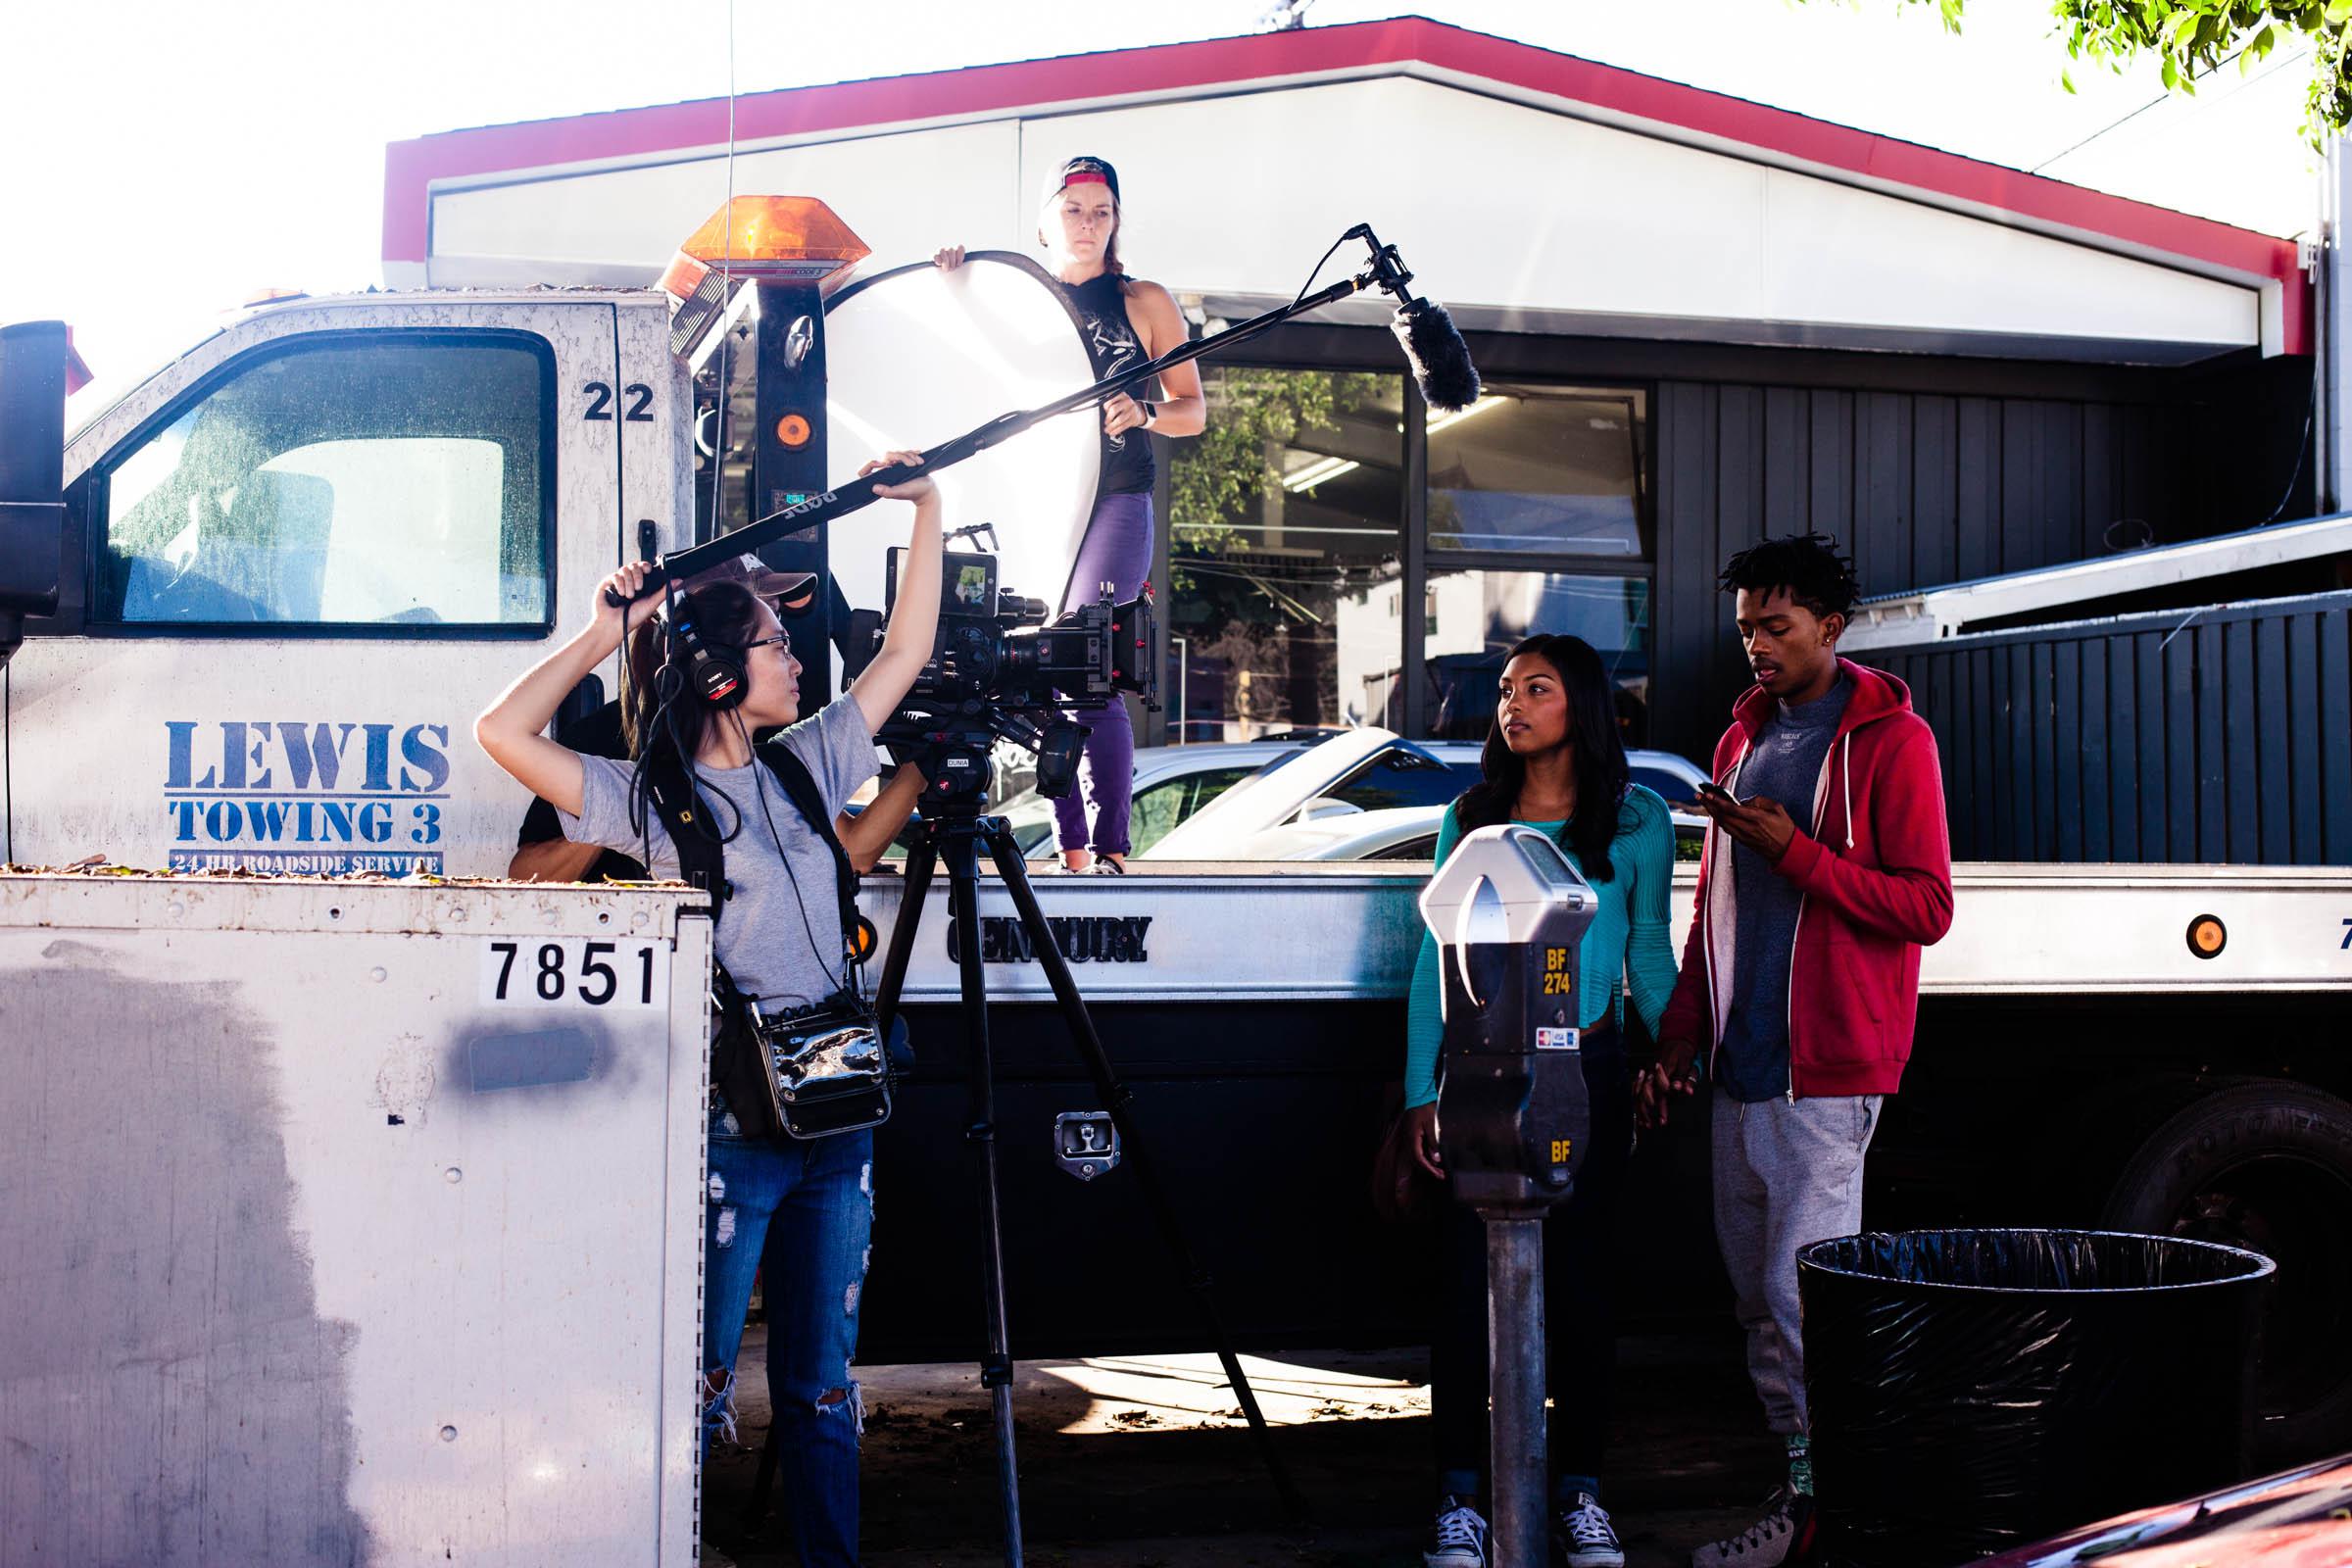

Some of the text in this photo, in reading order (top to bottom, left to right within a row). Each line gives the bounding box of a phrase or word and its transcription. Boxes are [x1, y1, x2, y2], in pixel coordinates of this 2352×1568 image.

[583, 381, 654, 421] 22
[164, 721, 450, 792] LEWIS
[169, 801, 441, 844] TOWING 3
[174, 854, 199, 871] 24
[206, 855, 236, 871] HR
[243, 855, 346, 872] ROADSIDE
[491, 942, 654, 1005] 7851
[1546, 948, 1567, 970] BF
[1544, 972, 1570, 995] 274
[1551, 1140, 1570, 1162] BF
